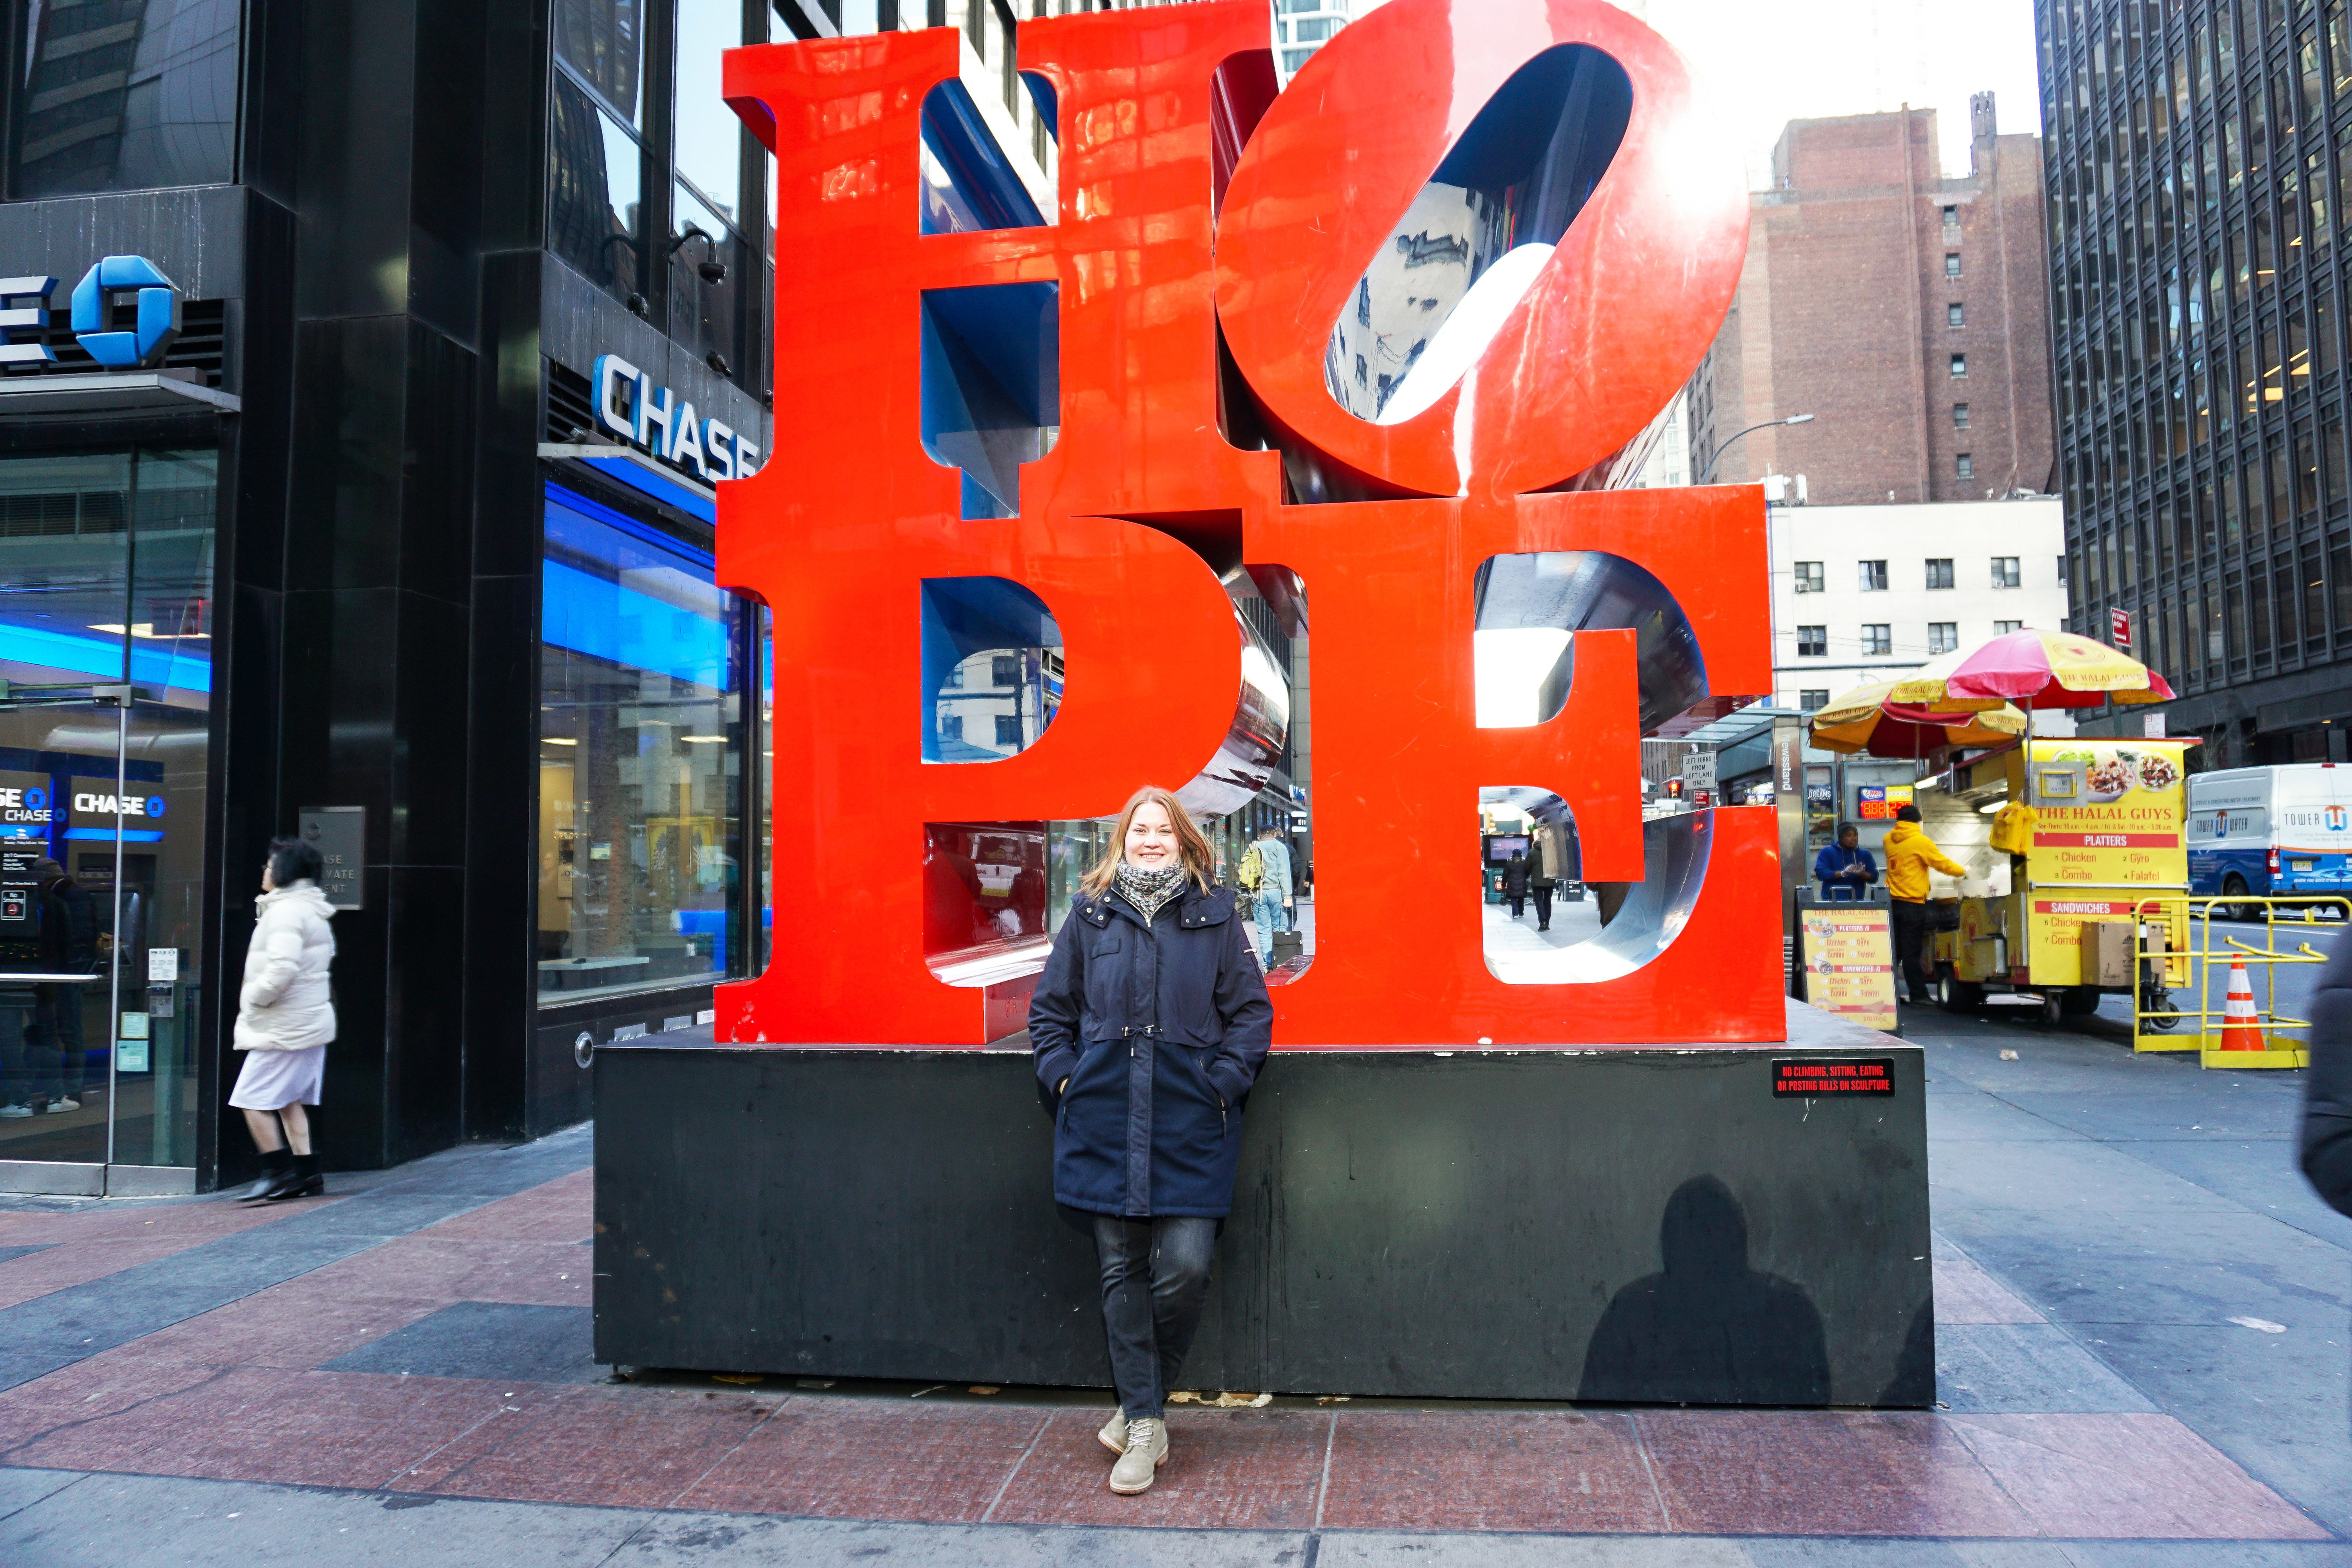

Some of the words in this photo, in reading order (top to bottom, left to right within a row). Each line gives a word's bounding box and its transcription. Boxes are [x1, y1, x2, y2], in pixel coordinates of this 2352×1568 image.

[592, 354, 758, 483] CHASE
[1781, 734, 1793, 791] Newsstand
[75, 793, 145, 815] CHASE
[5, 810, 52, 821] CHASE
[2036, 808, 2069, 819] THE
[2073, 808, 2126, 820] HALAL
[2131, 808, 2172, 820] GUYS
[2285, 813, 2320, 826] TOWER
[2197, 819, 2213, 833] TOWER
[2230, 817, 2248, 831] WATER
[2085, 835, 2127, 846] PLATTERS
[2061, 852, 2097, 863] Chicken
[2130, 853, 2149, 864] Gyro
[2061, 870, 2093, 880] Combo
[2131, 870, 2160, 881] Falafel
[2050, 902, 2110, 914] SANDWICHES
[2050, 935, 2082, 945] Combo
[1860, 977, 1873, 986] Gyro
[1782, 1067, 1792, 1077] NO
[1794, 1066, 1828, 1077] CLIMBING,
[1829, 1066, 1858, 1077] SITTING,
[1859, 1065, 1884, 1076] EATING
[1777, 1081, 1787, 1091] OR
[1789, 1081, 1818, 1091] POSTING
[1819, 1081, 1838, 1091] BILLS
[1840, 1081, 1849, 1091] ON
[1851, 1080, 1890, 1091] SCULPTURE
